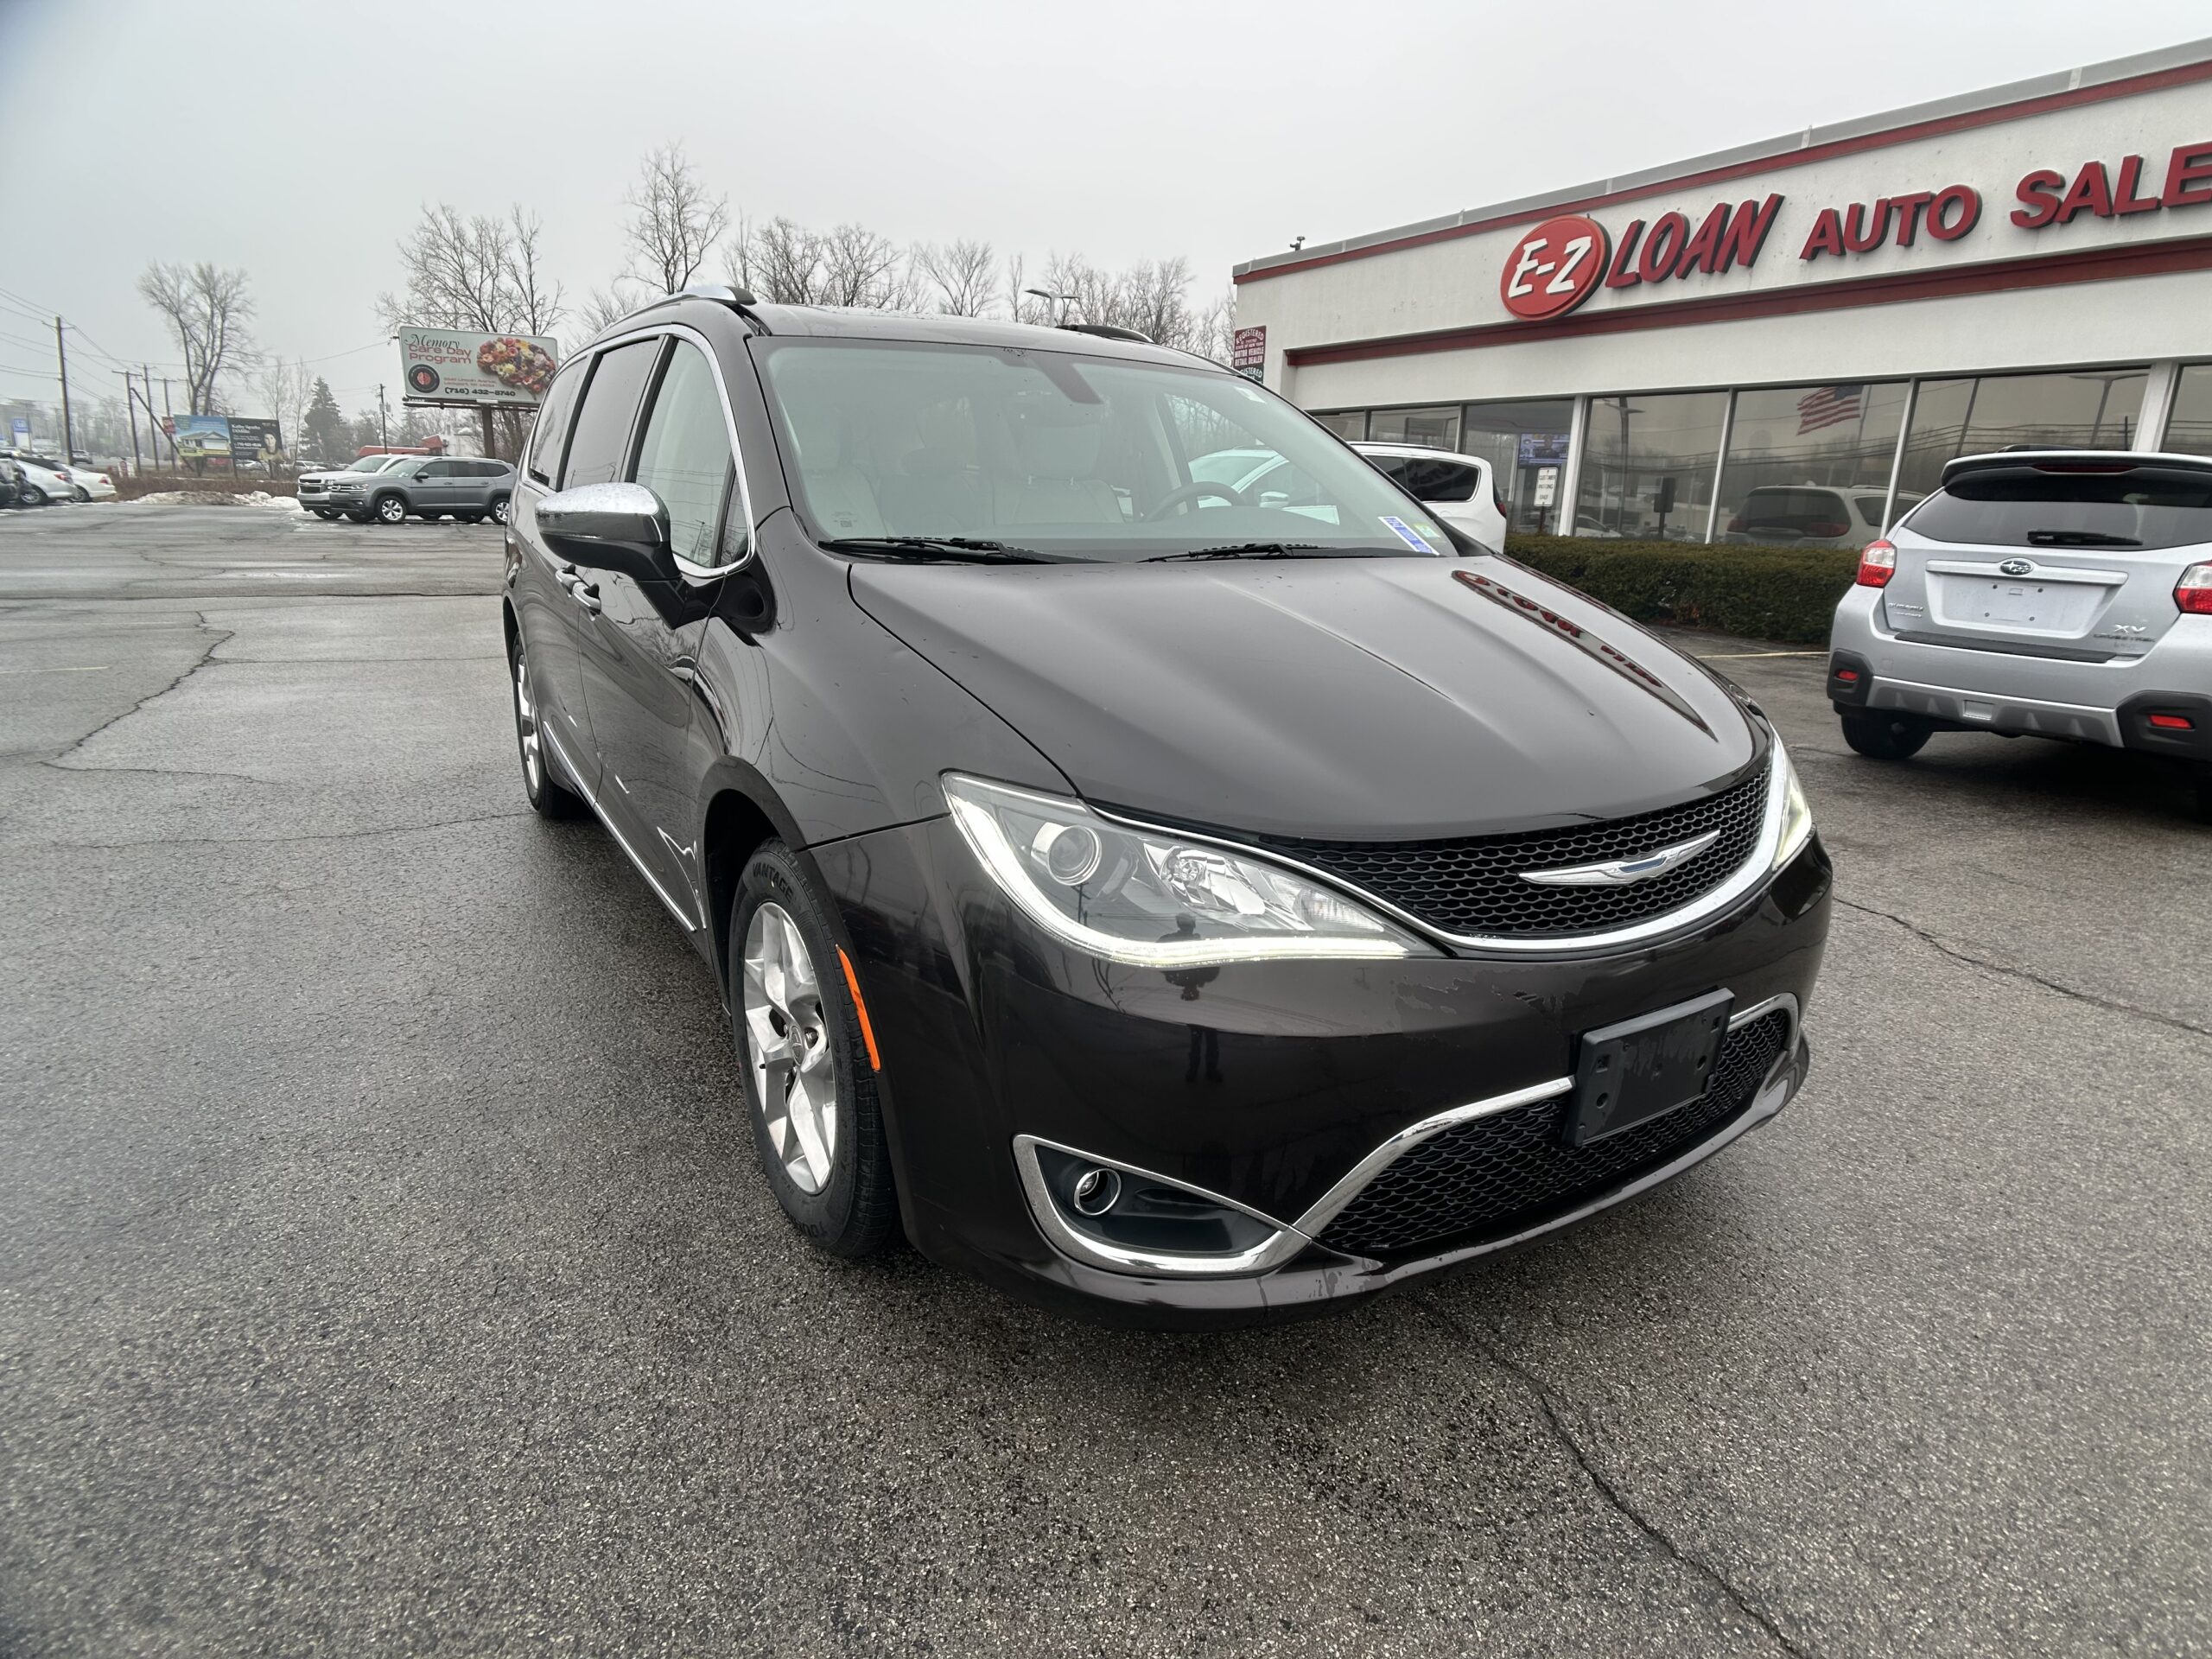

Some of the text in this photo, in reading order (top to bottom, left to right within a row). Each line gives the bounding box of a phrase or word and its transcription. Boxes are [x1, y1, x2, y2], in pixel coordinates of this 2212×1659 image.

[1508, 141, 2212, 298] E-Z LOAN AUTO SALE
[404, 334, 460, 349] Memory
[1236, 328, 1264, 345] REGISTERED
[409, 344, 472, 358] Care Day
[1235, 346, 1264, 359] MOTOR VEHICLE
[409, 353, 472, 364] Program
[1235, 355, 1263, 366] RETAIL DEALER
[2113, 624, 2146, 633] XV
[753, 862, 794, 903] VANTAGE
